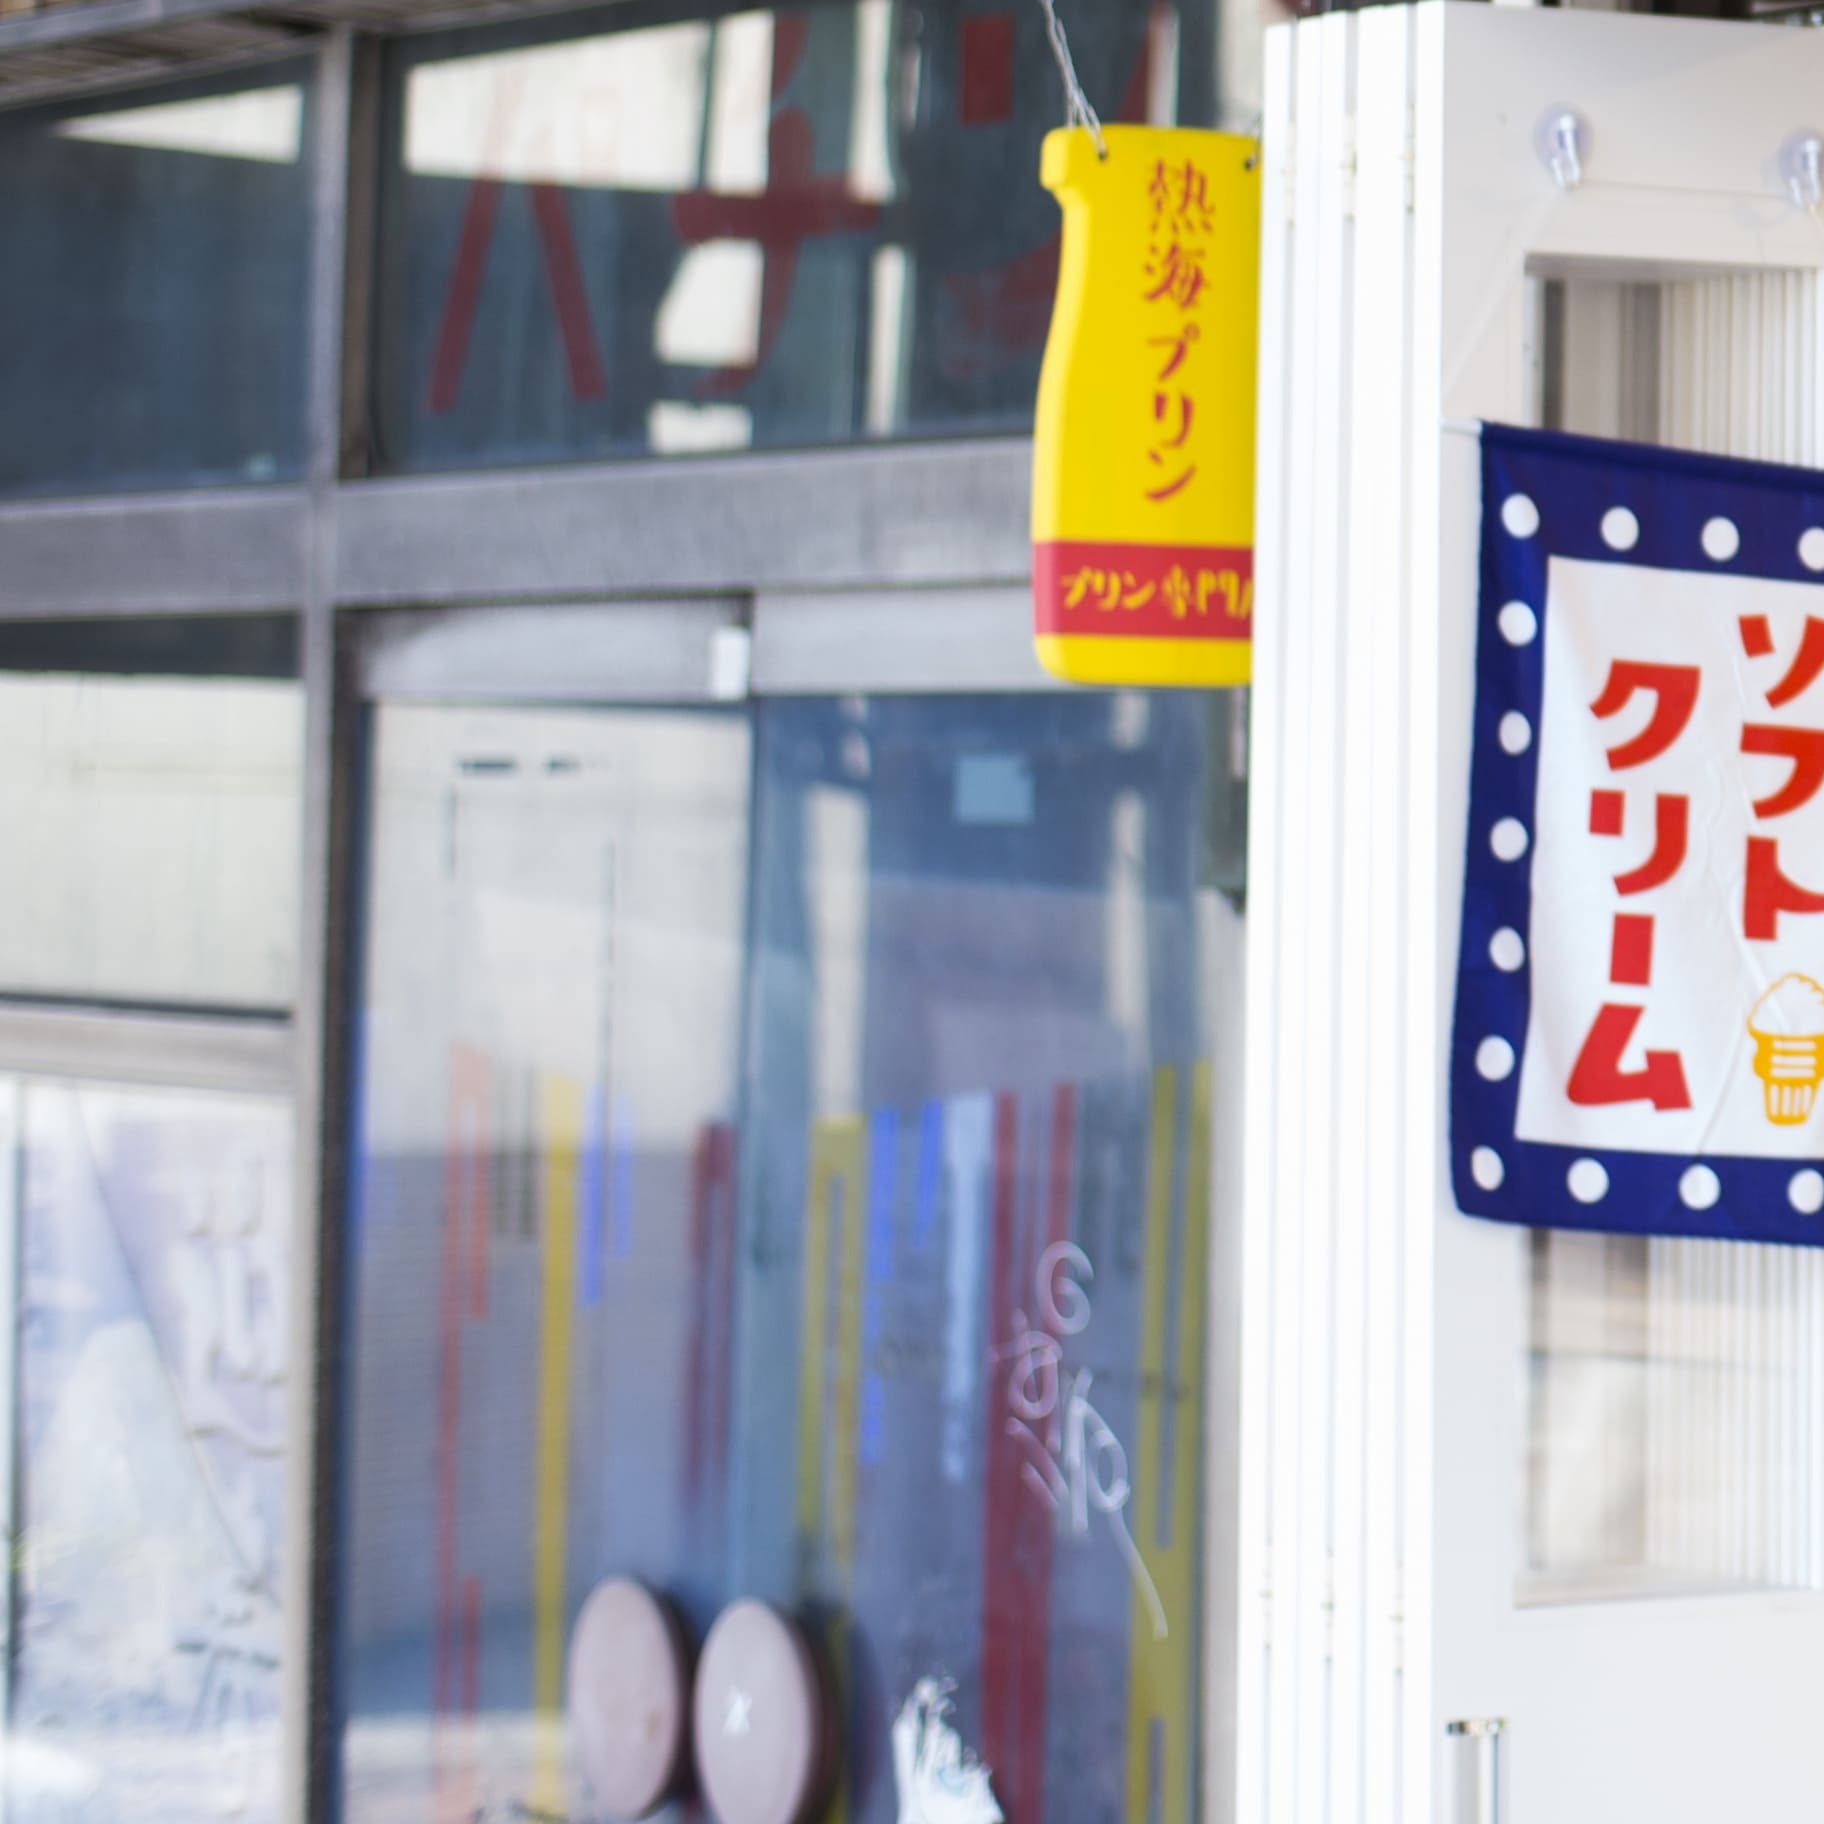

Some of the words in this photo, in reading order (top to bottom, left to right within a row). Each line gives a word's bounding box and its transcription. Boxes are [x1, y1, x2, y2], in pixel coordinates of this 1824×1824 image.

[1142, 159, 1215, 502] 熱海プリン
[1566, 660, 1701, 1111] クリーム
